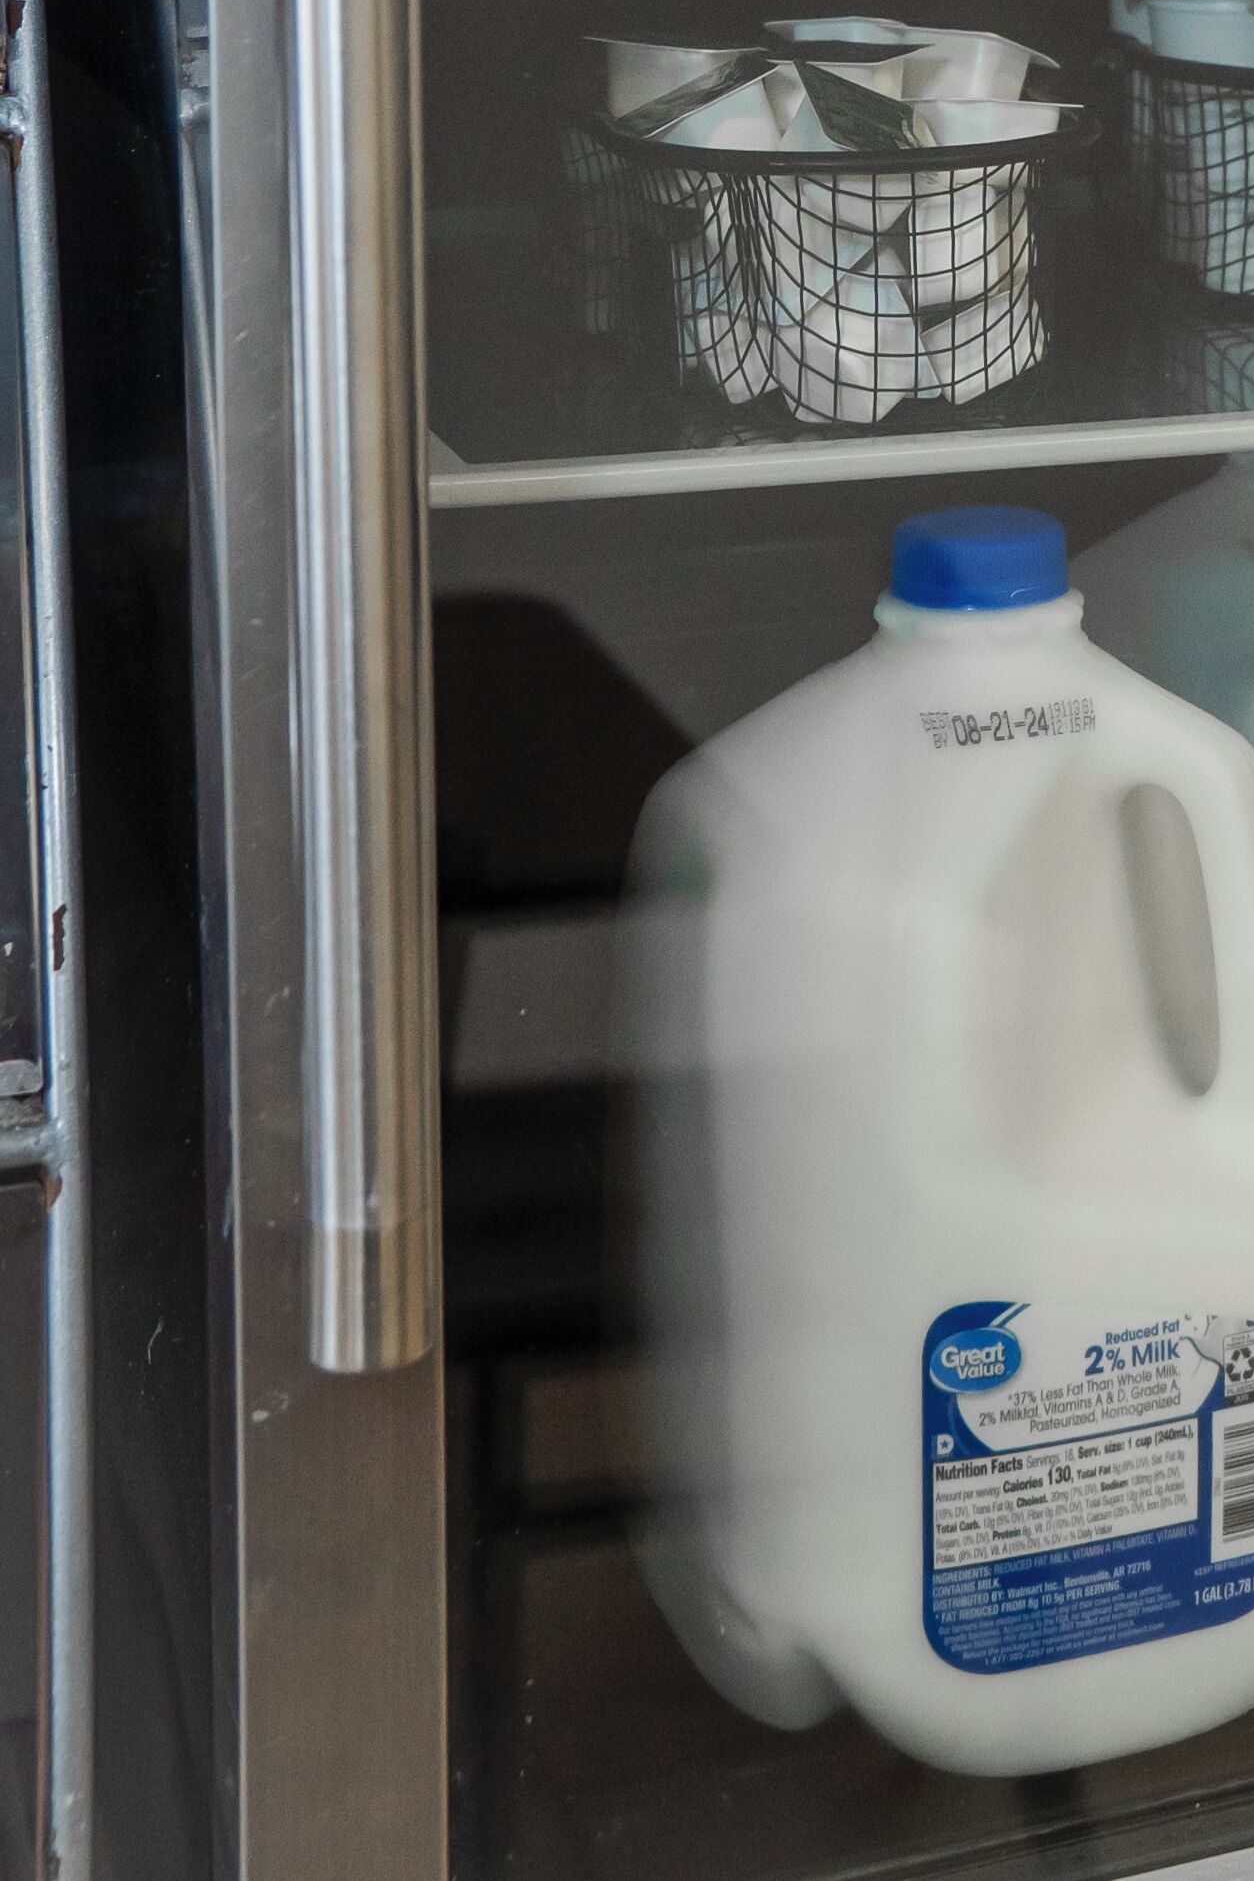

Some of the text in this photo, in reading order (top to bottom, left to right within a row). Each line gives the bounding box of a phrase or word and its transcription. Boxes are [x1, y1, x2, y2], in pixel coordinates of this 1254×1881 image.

[1105, 1319, 1181, 1345] Reduced Fat
[940, 1341, 1006, 1368] Great
[1084, 1338, 1181, 1377] 2% Milk
[956, 1363, 1006, 1380] Value
[1040, 1386, 1064, 1402] Less
[1066, 1382, 1084, 1398] Fat
[1087, 1379, 1114, 1393] Than
[1117, 1371, 1153, 1386] Whole
[979, 1411, 997, 1427] 2%
[1043, 1396, 1093, 1416] Vitamins
[1095, 1394, 1103, 1407] A
[1106, 1391, 1114, 1404] &
[1130, 1382, 1168, 1399] Grade
[1101, 1393, 1181, 1417] Homogenized
[935, 1461, 988, 1482] Nutrition
[990, 1456, 1024, 1475] Facts
[1077, 1445, 1102, 1460] Serv.
[1127, 1437, 1133, 1449] 1
[1135, 1435, 1153, 1449] cup
[1002, 1475, 1044, 1494] Calories
[1046, 1464, 1075, 1486] 130,
[1076, 1467, 1098, 1480] Total
[1098, 1464, 1113, 1476] Fat
[936, 1519, 981, 1535] Total Carb.
[992, 1528, 1022, 1541] Protein
[932, 1581, 976, 1598] CONTAINS
[1006, 1583, 1043, 1599] Walmart
[1112, 1564, 1125, 1578] AR
[1127, 1559, 1152, 1575] 72716
[1193, 1589, 1200, 1607] 1
[1201, 1582, 1224, 1604] GAL
[1224, 1576, 1252, 1601] (3.78
[959, 1603, 1000, 1620] REDUCED
[1001, 1599, 1027, 1614] FROM
[1066, 1589, 1083, 1601] PER
